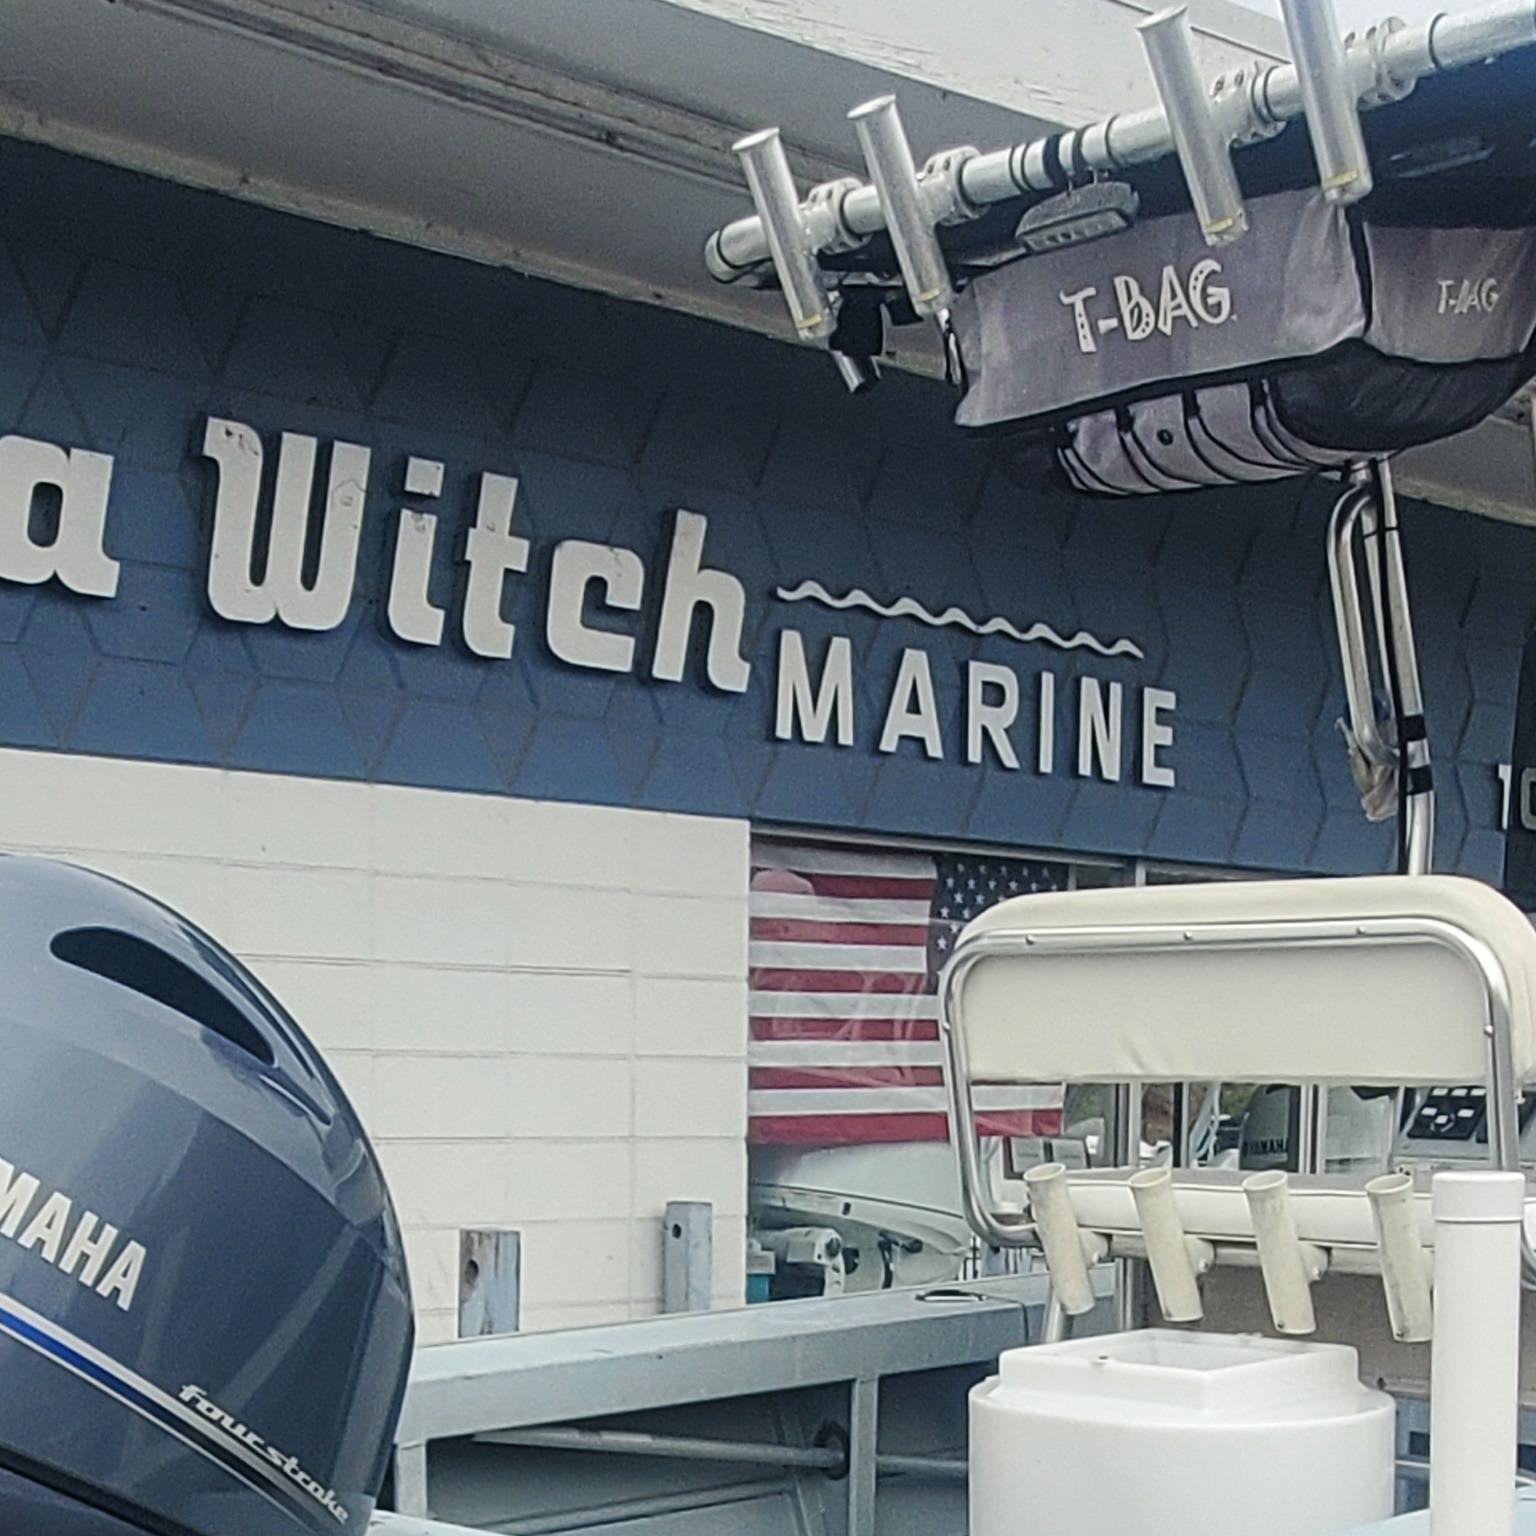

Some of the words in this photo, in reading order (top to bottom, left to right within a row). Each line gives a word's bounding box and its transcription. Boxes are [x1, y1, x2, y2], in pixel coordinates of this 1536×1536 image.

[1059, 258, 1231, 352] T-BAG
[203, 416, 750, 693] Witch
[775, 630, 1176, 787] MARINE
